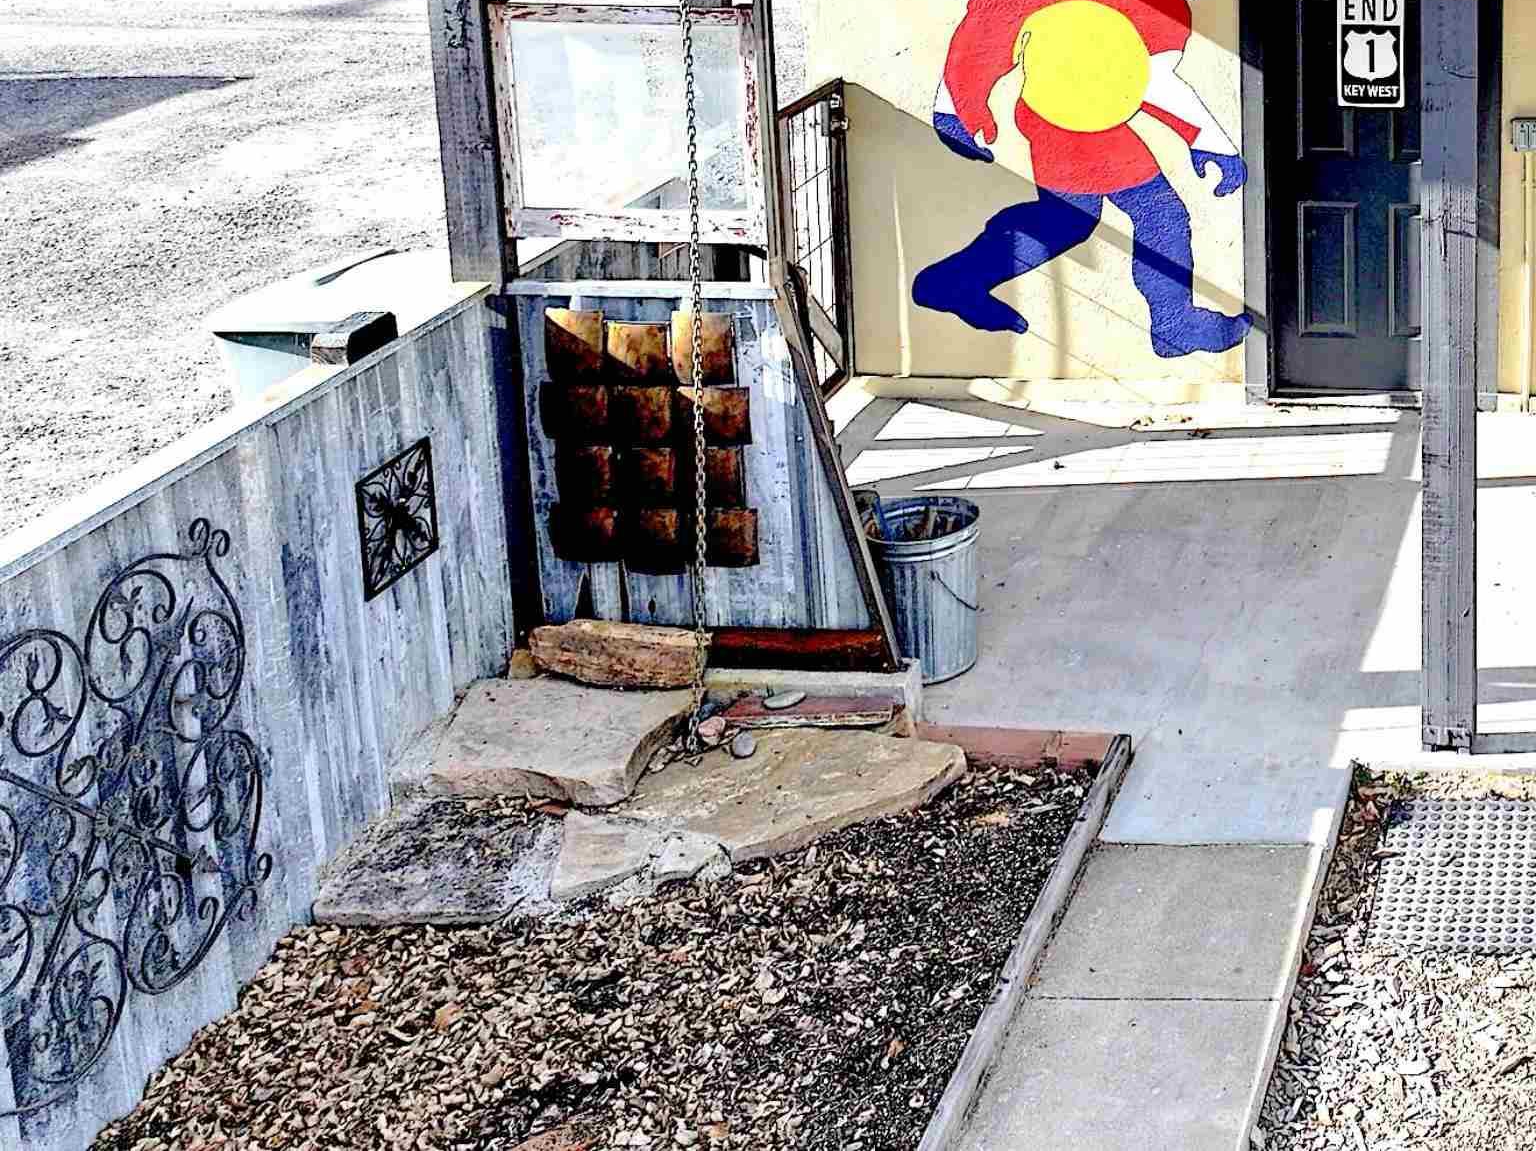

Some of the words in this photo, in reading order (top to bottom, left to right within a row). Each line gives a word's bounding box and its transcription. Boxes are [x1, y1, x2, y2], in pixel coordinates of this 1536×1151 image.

[1365, 38, 1376, 73] 1
[1343, 84, 1366, 97] KEY
[1366, 84, 1400, 98] WEST
